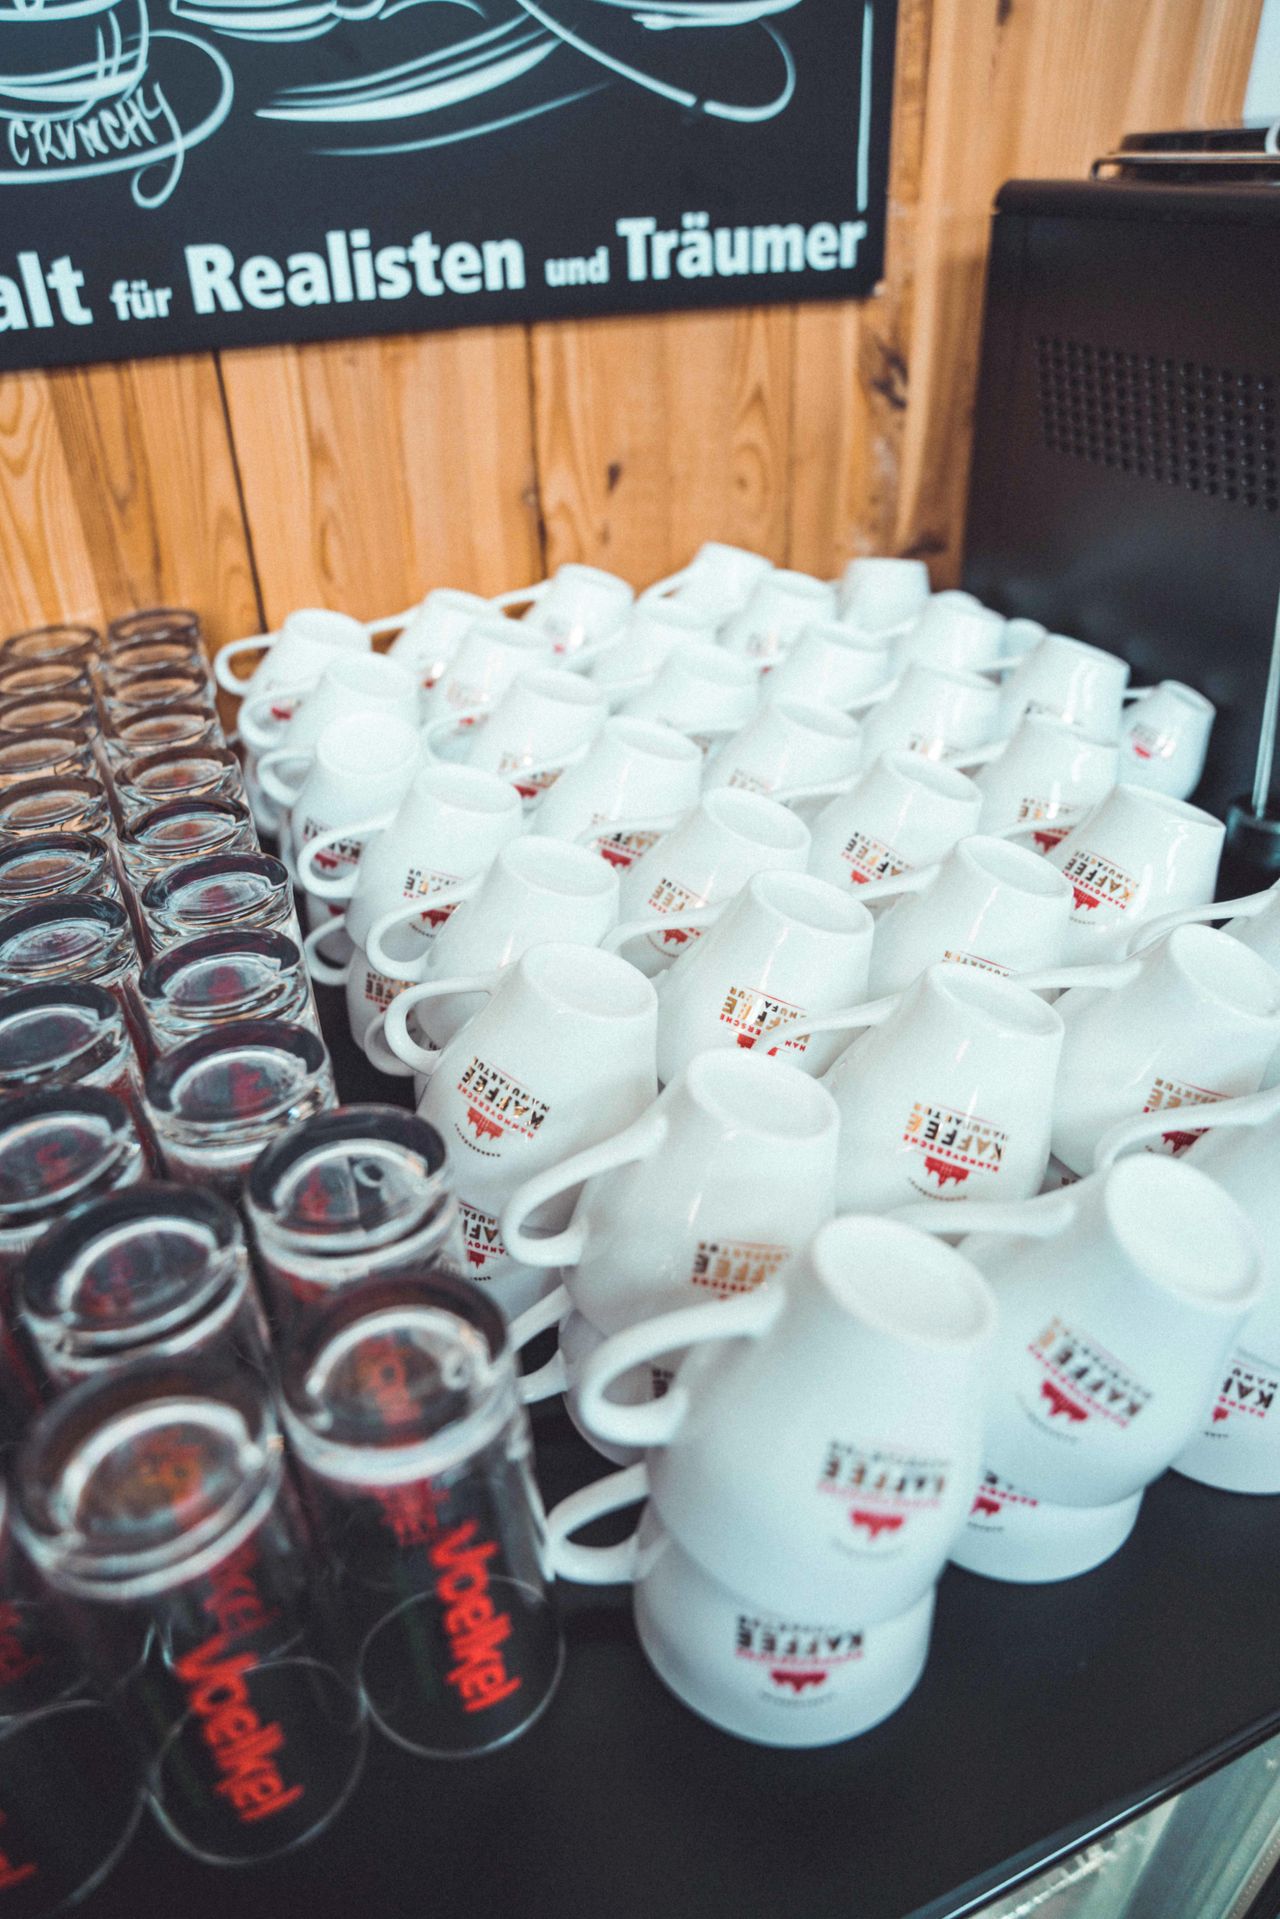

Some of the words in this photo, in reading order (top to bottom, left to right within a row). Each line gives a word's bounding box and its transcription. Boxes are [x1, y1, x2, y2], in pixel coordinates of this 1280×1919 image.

[109, 279, 173, 321] für
[184, 228, 526, 314] Realisten
[544, 246, 610, 287] und
[616, 211, 869, 282] Träumer
[906, 1113, 1003, 1162] KAFFEE
